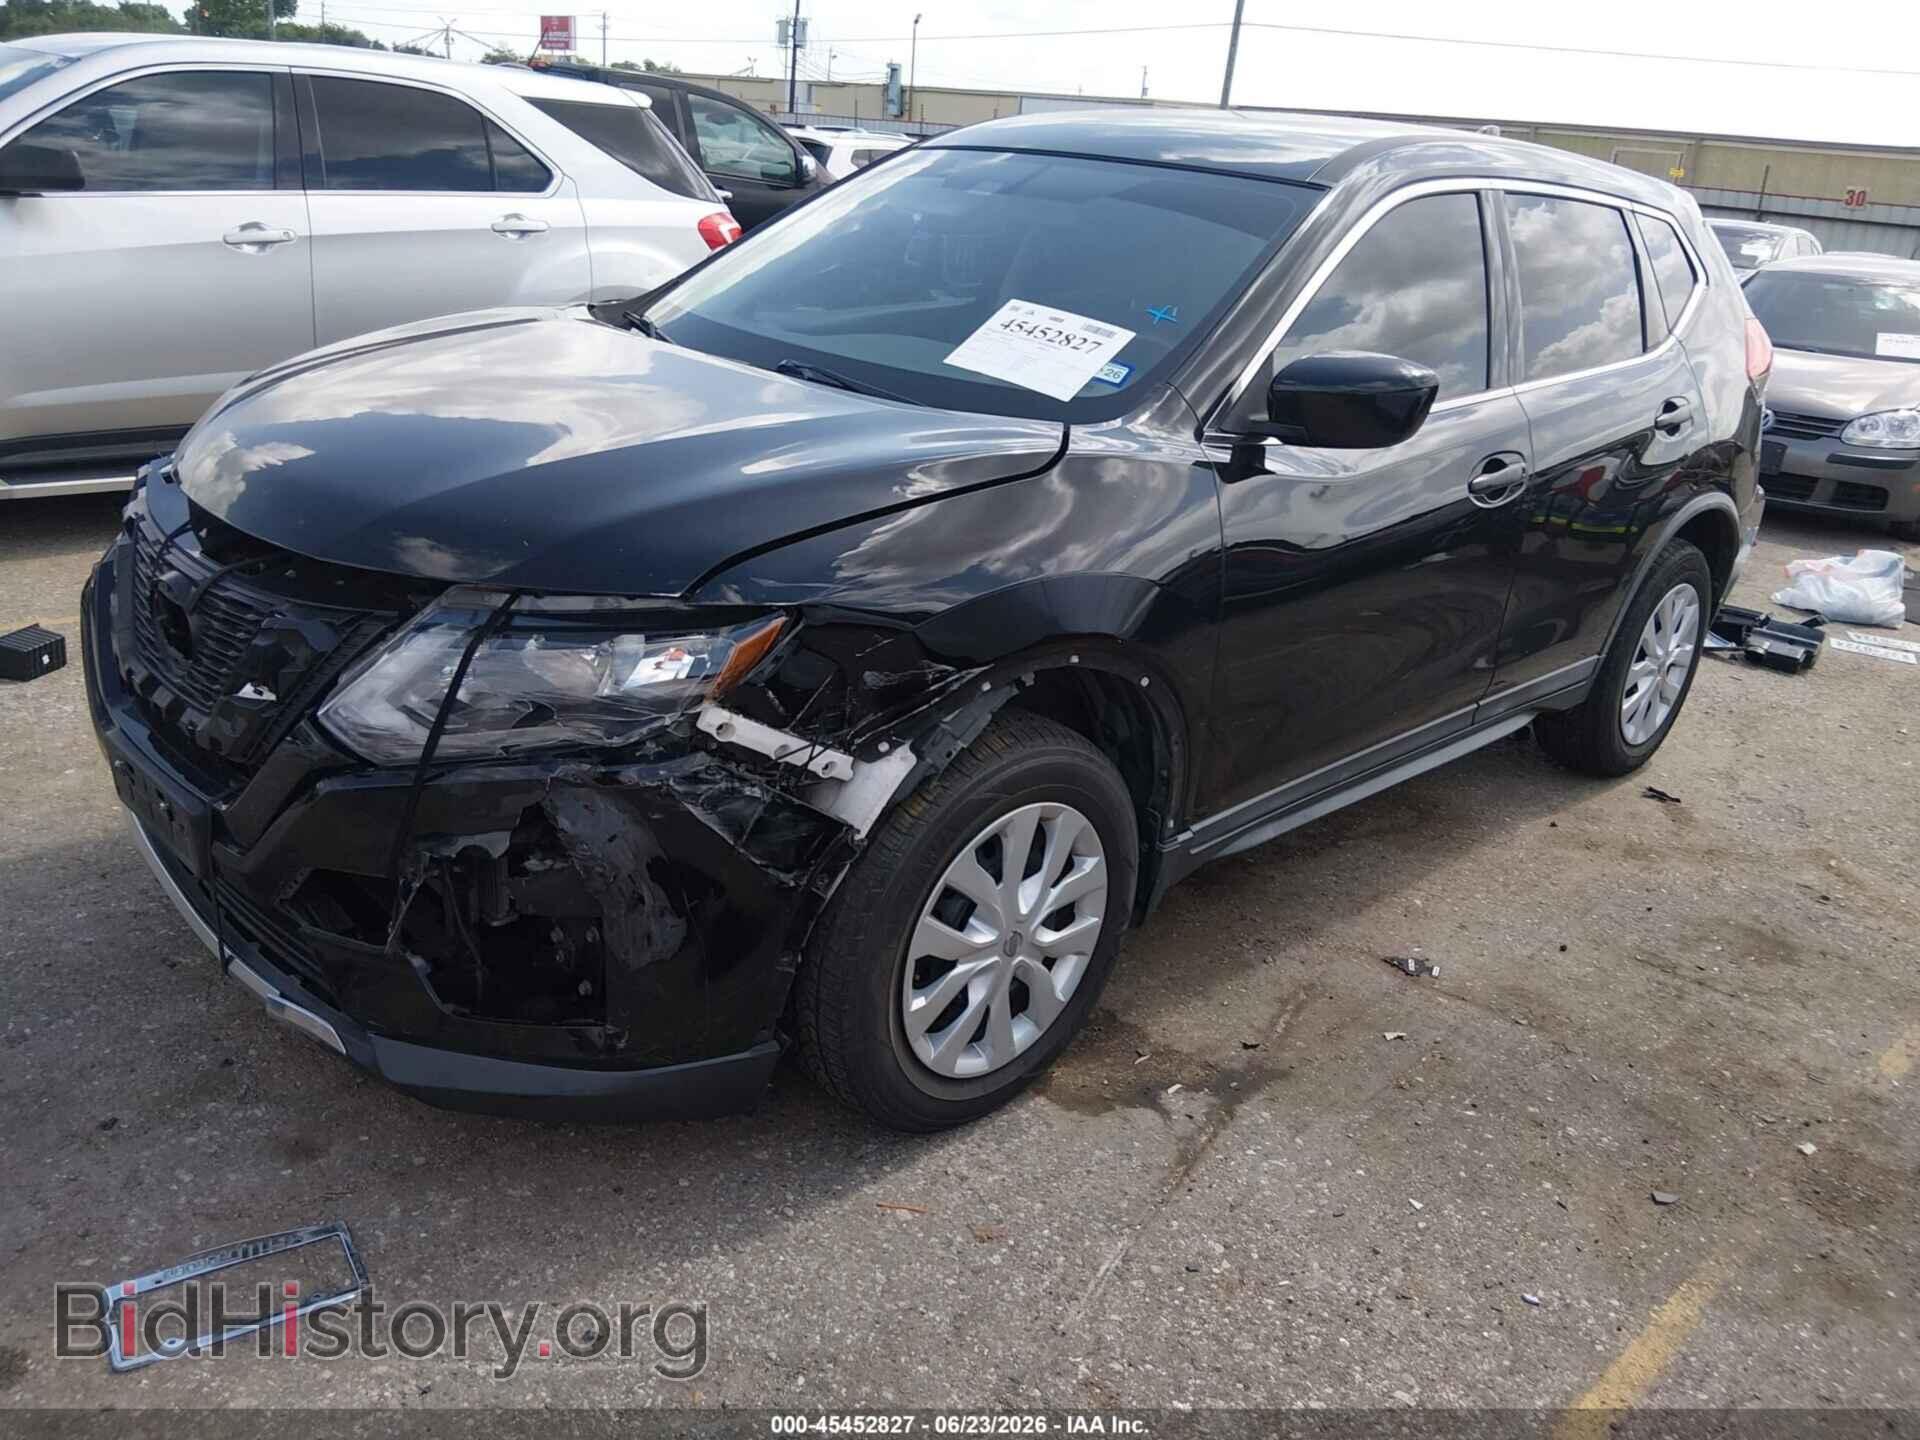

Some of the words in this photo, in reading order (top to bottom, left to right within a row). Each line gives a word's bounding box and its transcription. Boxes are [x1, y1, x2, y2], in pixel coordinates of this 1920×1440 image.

[1845, 190, 1866, 206] 30
[1000, 318, 1103, 355] 45452827
[1104, 368, 1123, 380] 26
